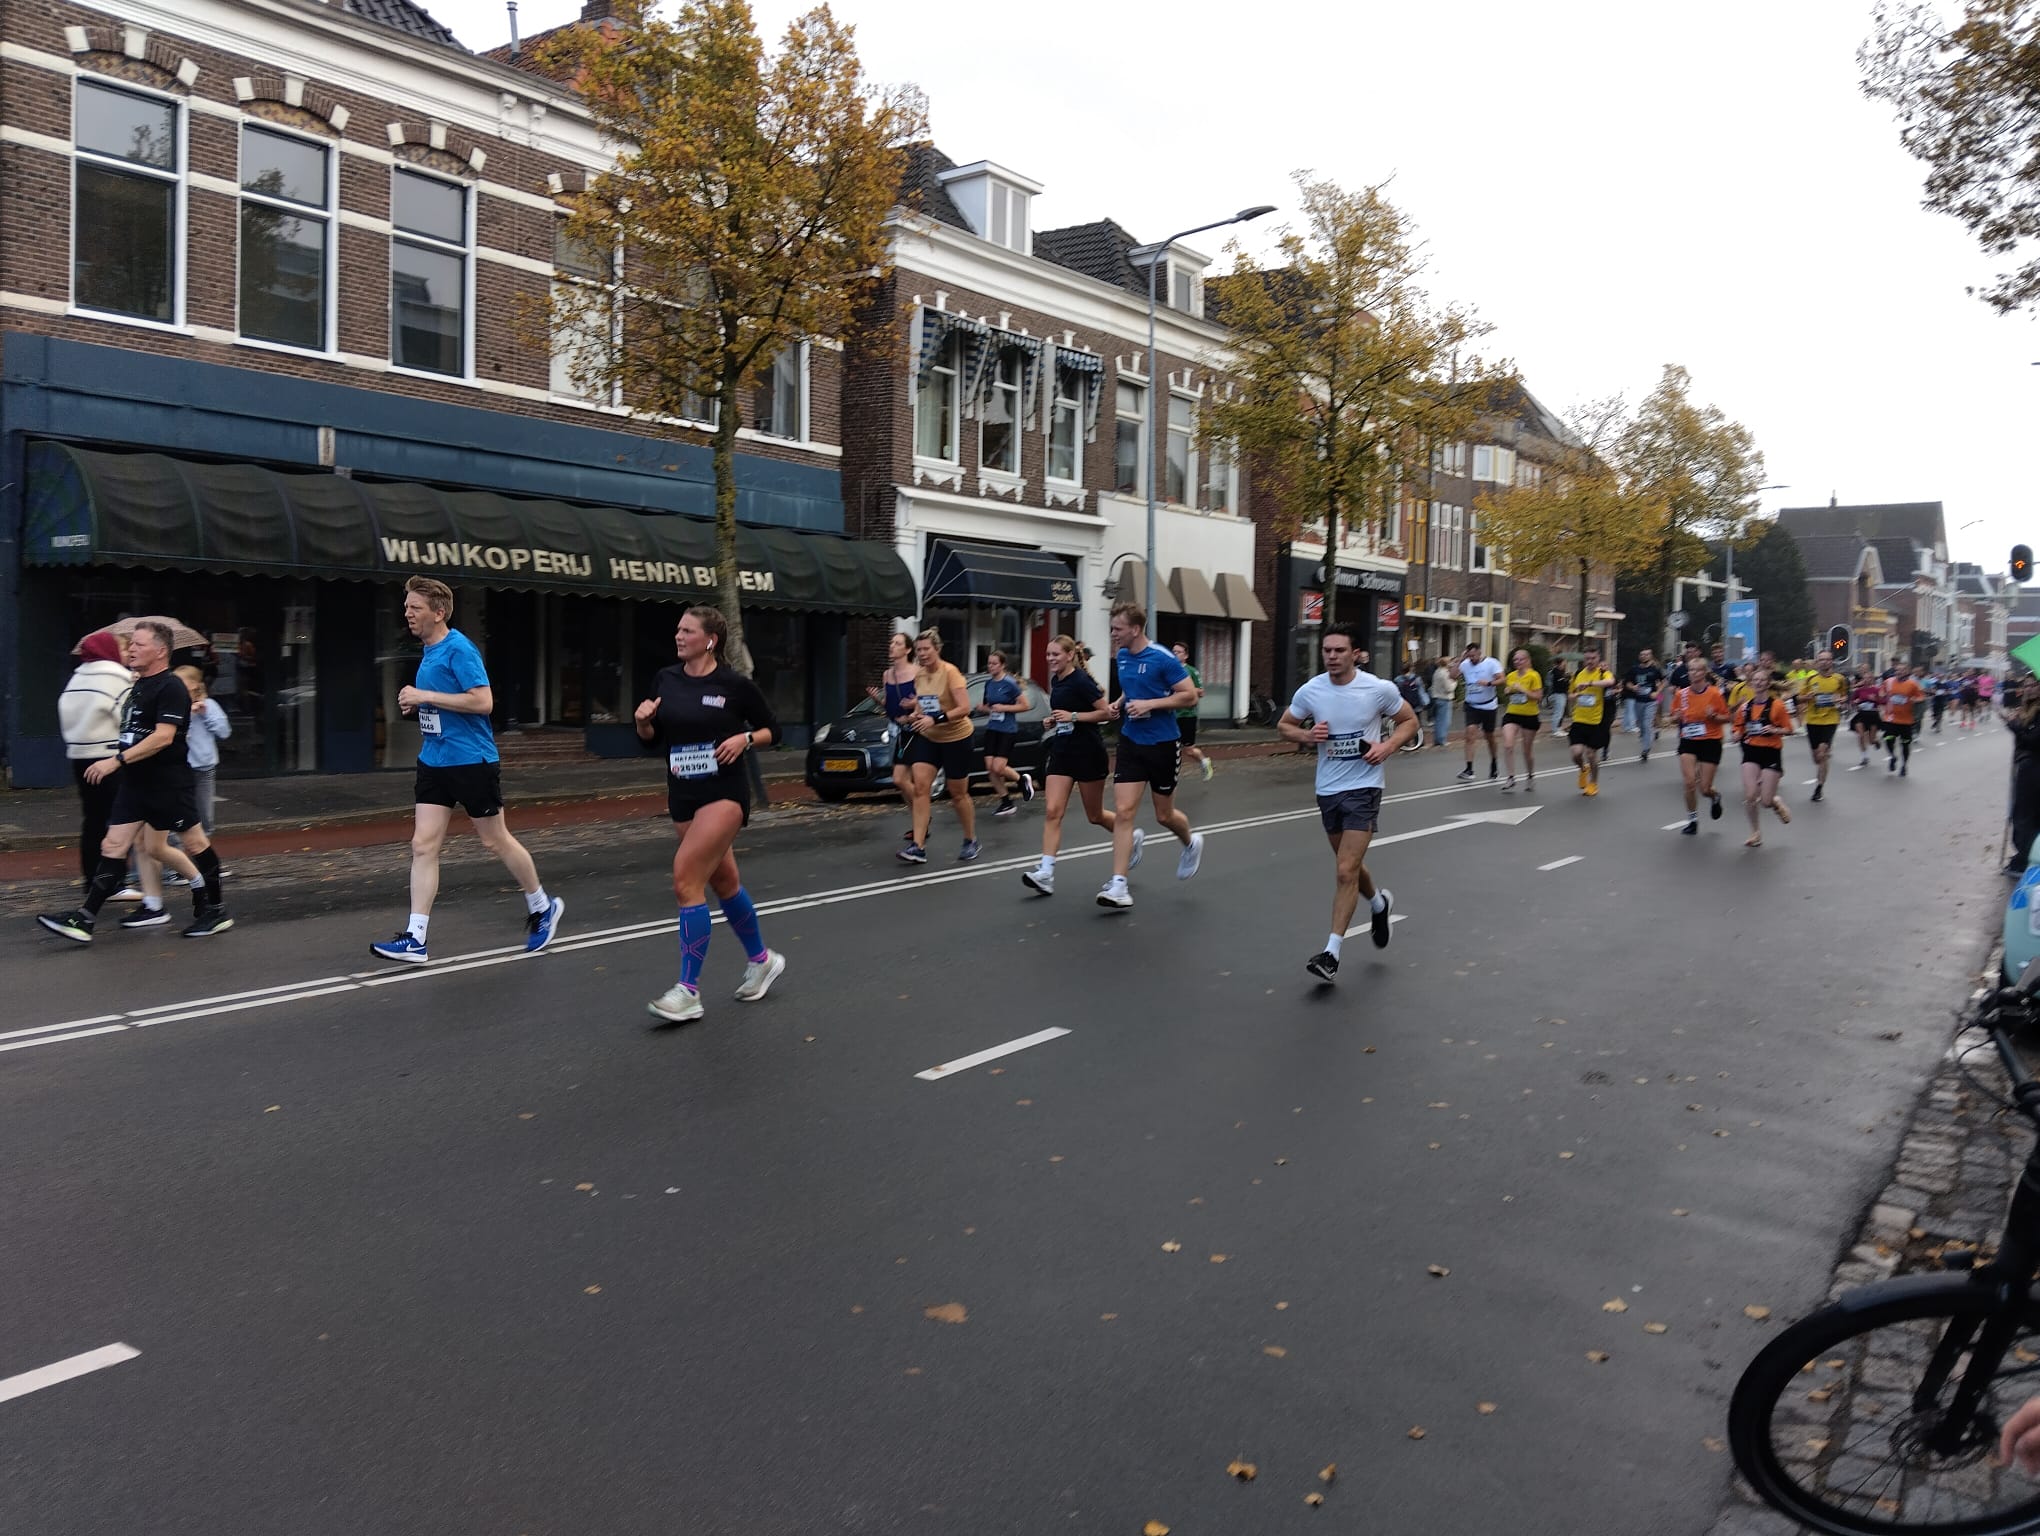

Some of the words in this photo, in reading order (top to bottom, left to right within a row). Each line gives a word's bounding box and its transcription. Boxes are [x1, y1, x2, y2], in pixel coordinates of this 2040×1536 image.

[380, 537, 593, 577] WIJNKOPERIJ
[608, 558, 691, 585] HENRI
[692, 566, 776, 592] BLEM
